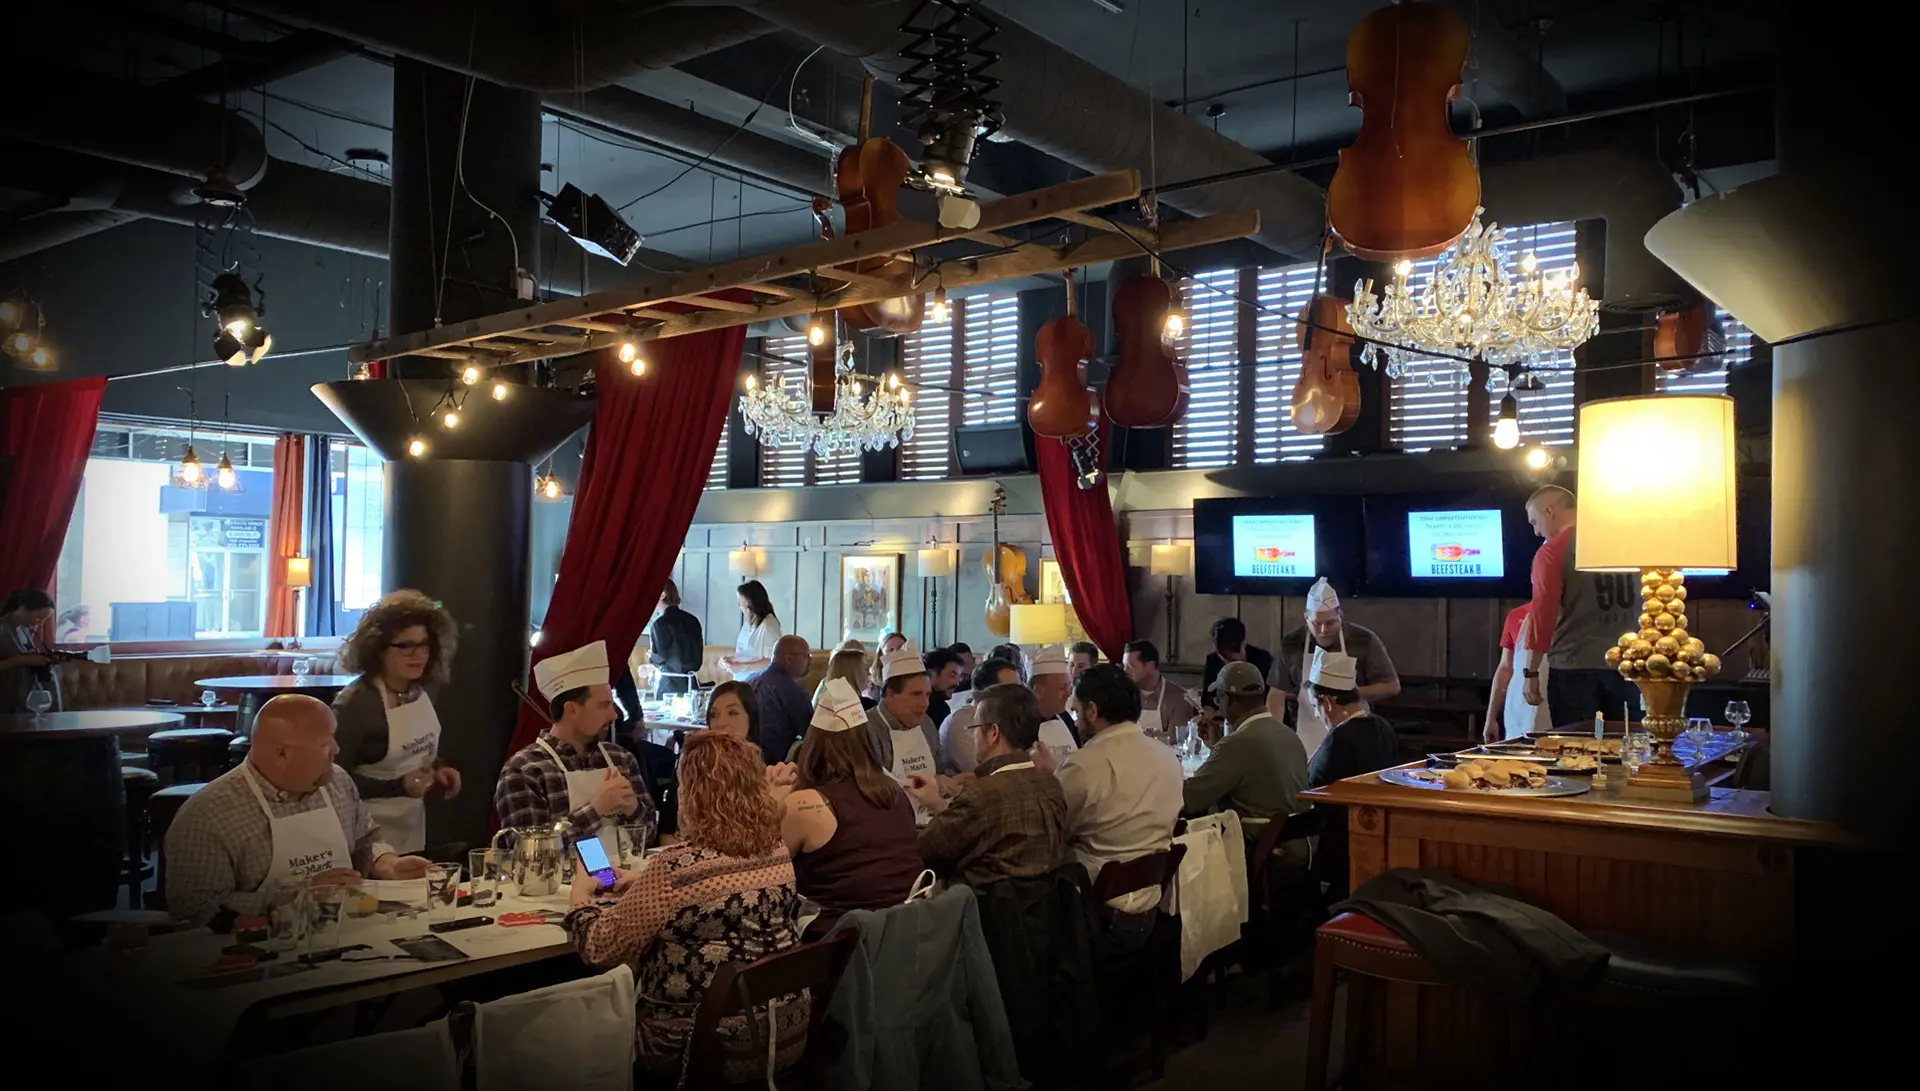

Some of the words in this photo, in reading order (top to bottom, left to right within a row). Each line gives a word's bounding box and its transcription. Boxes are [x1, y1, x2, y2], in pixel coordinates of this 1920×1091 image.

[1251, 564, 1289, 575] BEEFSTEAK
[1431, 563, 1475, 575] BEEFSTEAK
[288, 849, 333, 869] Maker's
